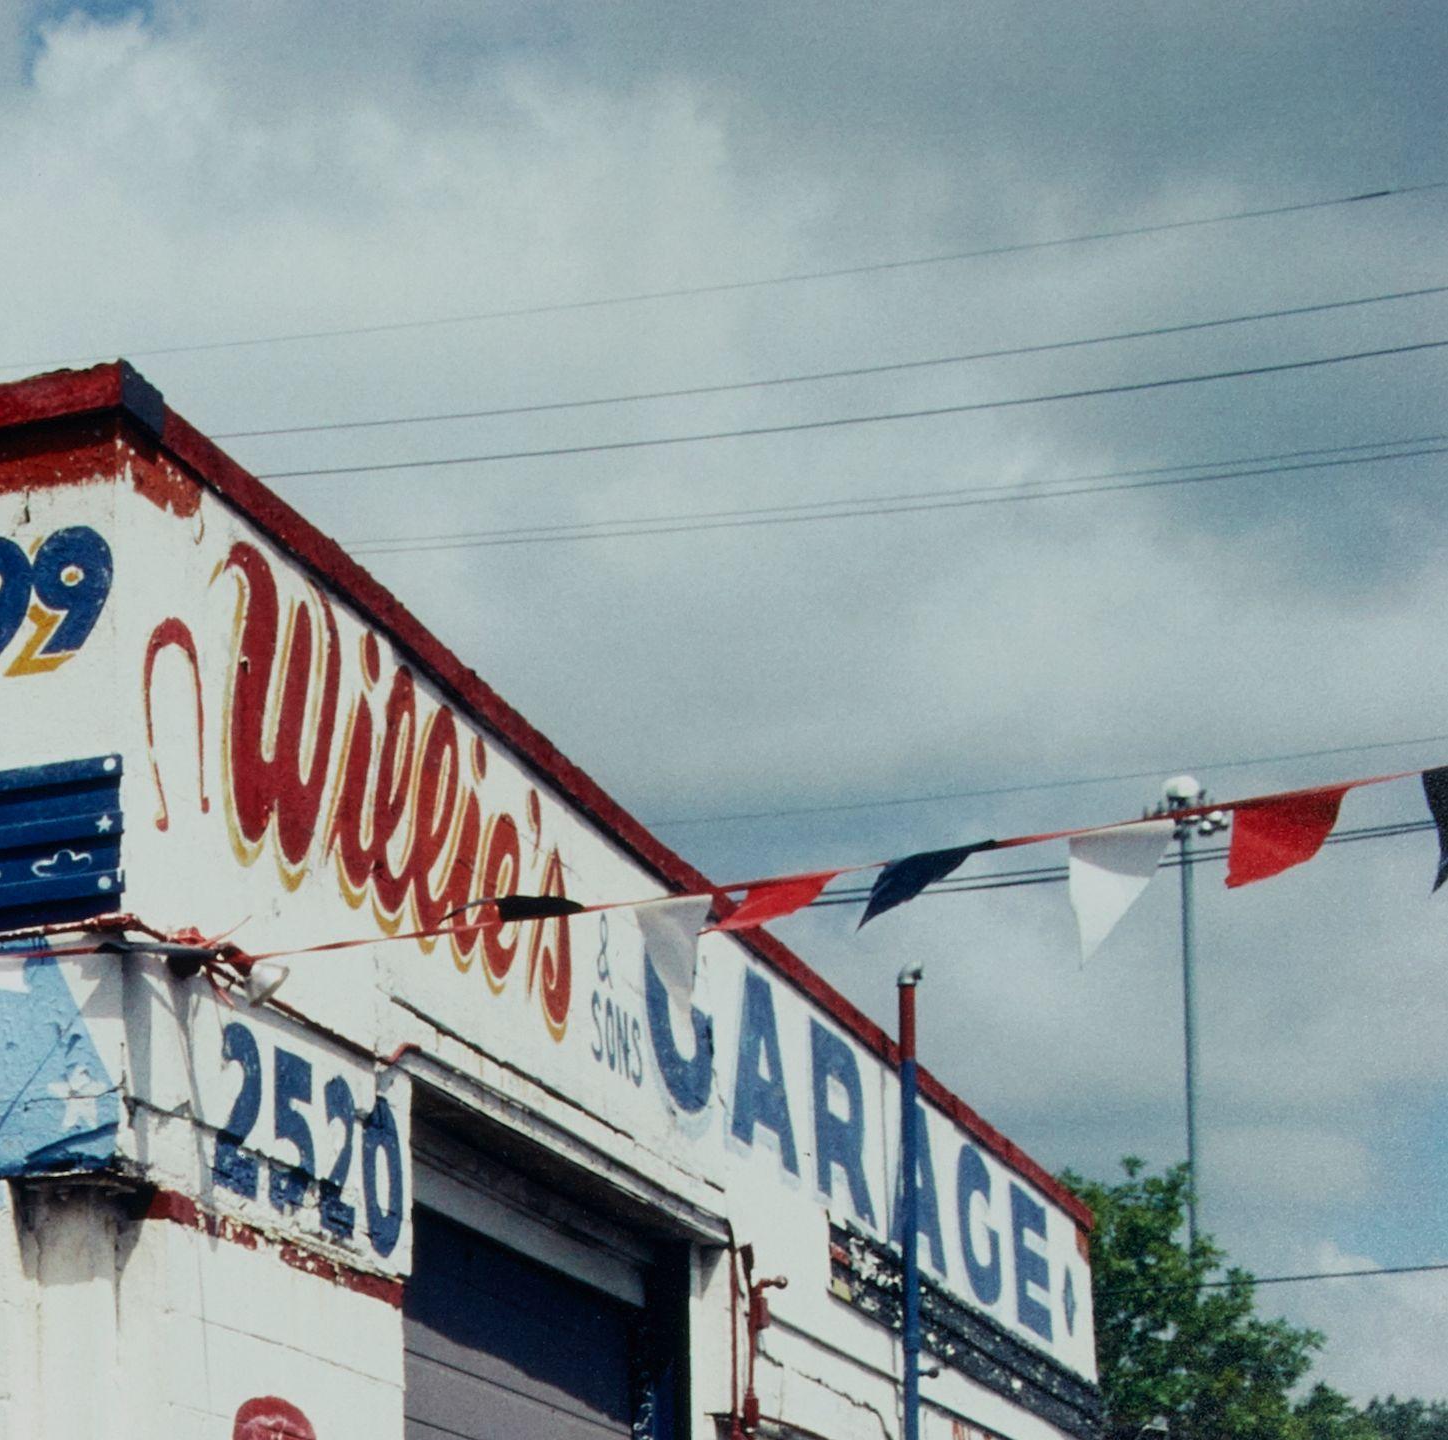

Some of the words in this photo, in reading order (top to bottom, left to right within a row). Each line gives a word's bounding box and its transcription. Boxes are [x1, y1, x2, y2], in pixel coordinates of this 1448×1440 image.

[211, 541, 573, 1042] Willie's
[596, 912, 614, 989] &
[591, 989, 643, 1088] SONS
[212, 1022, 403, 1258] 2520
